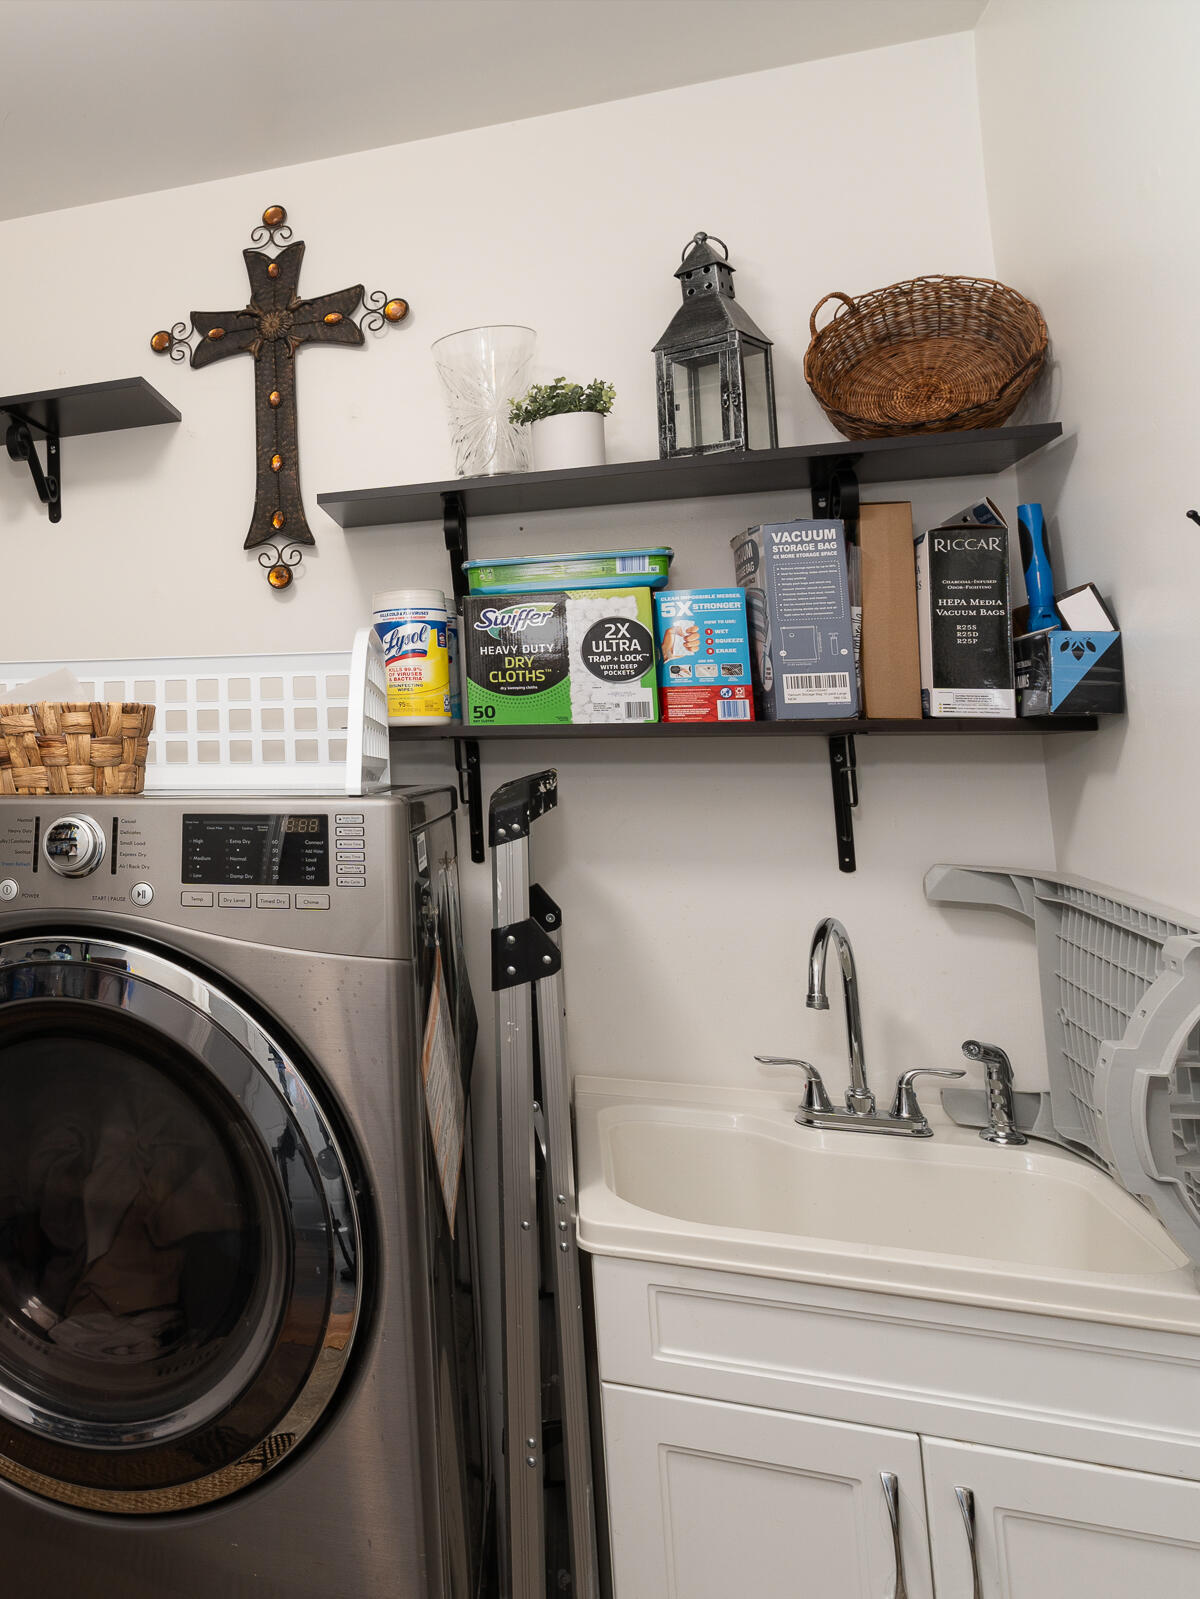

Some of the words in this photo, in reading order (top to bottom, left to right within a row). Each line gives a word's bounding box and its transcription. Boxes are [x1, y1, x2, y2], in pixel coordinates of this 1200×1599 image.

[772, 529, 836, 543] VACUUM
[772, 544, 815, 552] STORAGE
[818, 542, 837, 550] BAG
[934, 538, 1002, 552] RICCAR
[661, 601, 694, 617] 5X
[692, 602, 742, 610] STRONGER
[474, 608, 554, 633] Swiffer
[604, 623, 630, 638] 2X
[384, 624, 428, 656] Lysol
[592, 639, 641, 652] ULTRA
[480, 646, 517, 655] HEAVY
[522, 644, 554, 654] DUTY
[505, 656, 534, 668] DRY
[588, 655, 612, 663] TRAP
[473, 705, 496, 719] 50
